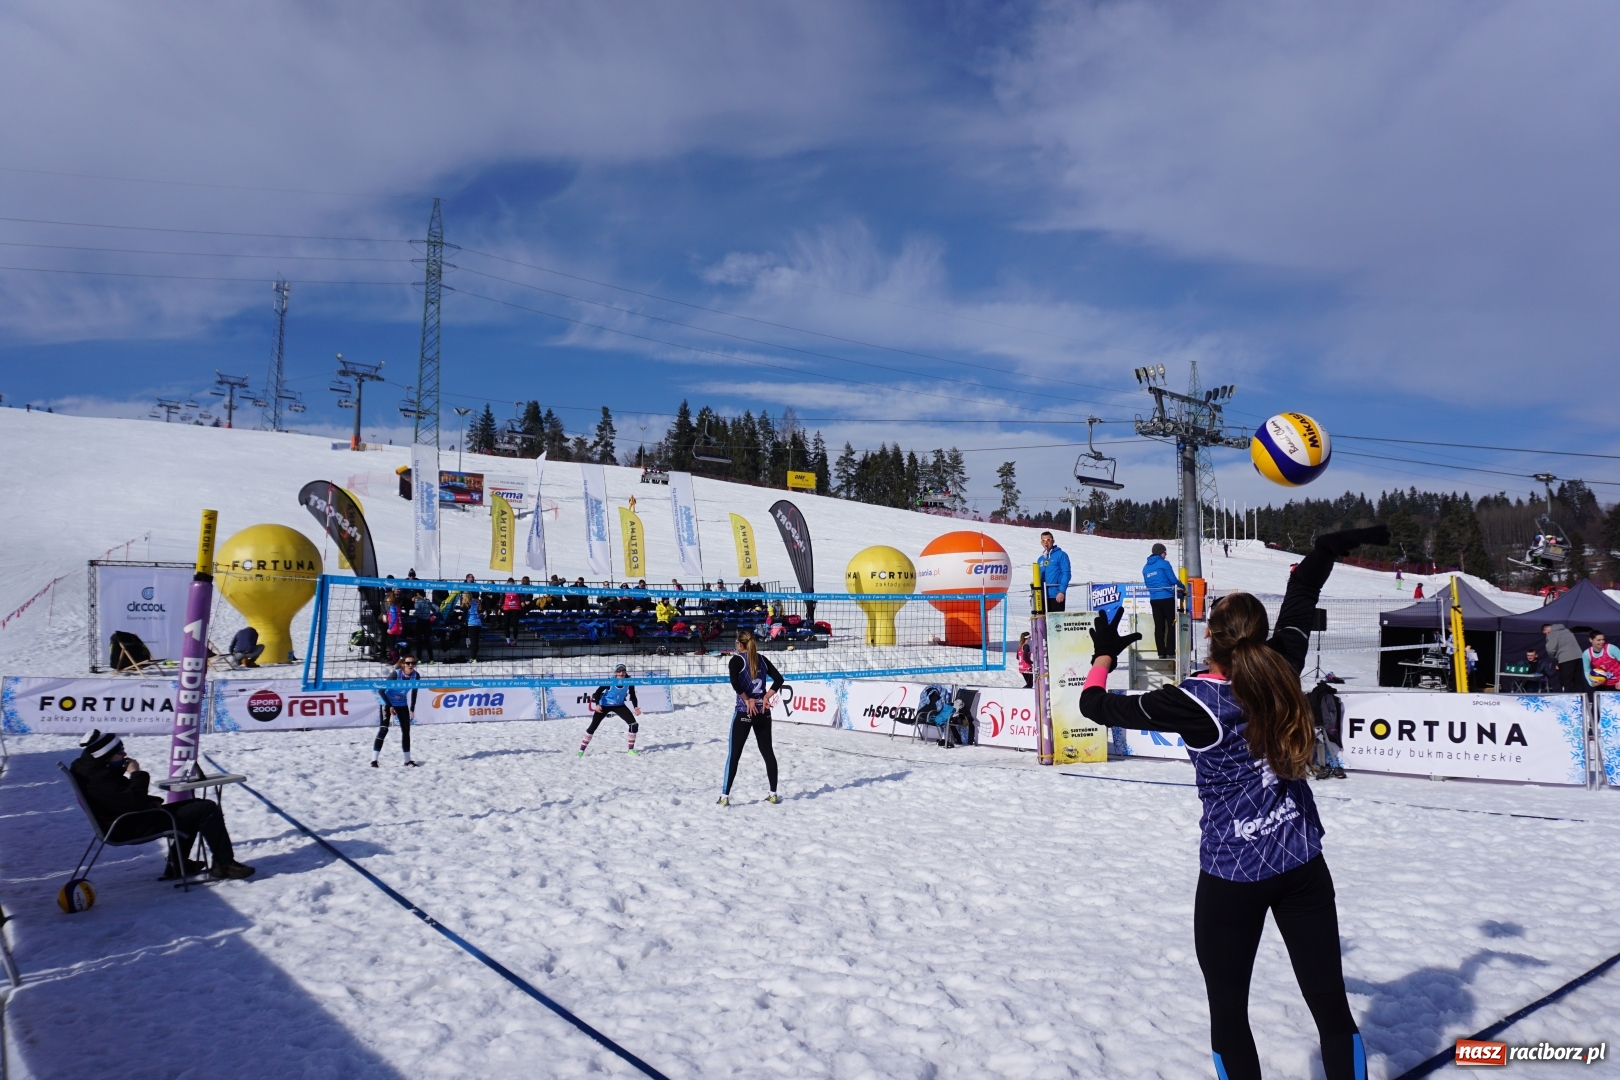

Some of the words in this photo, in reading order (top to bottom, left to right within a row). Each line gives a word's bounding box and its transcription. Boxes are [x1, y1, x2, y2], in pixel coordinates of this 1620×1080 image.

[232, 560, 315, 571] FORTUNA
[964, 559, 1008, 575] Terma
[1093, 586, 1116, 599] SNOW
[1093, 592, 1120, 607] VOLLEY
[179, 657, 203, 704] BDB
[752, 678, 763, 694] 2
[39, 696, 174, 712] FORTUNA
[288, 693, 348, 717] rent
[429, 688, 505, 709] Terma
[781, 684, 826, 717] RULES
[40, 715, 84, 723] zakłady
[863, 704, 915, 720] rhSPORT
[1349, 718, 1528, 746] FORTUNA
[172, 713, 198, 777] EVEN
[1351, 747, 1402, 758] zakłady
[1410, 749, 1522, 763] bukmacherskie
